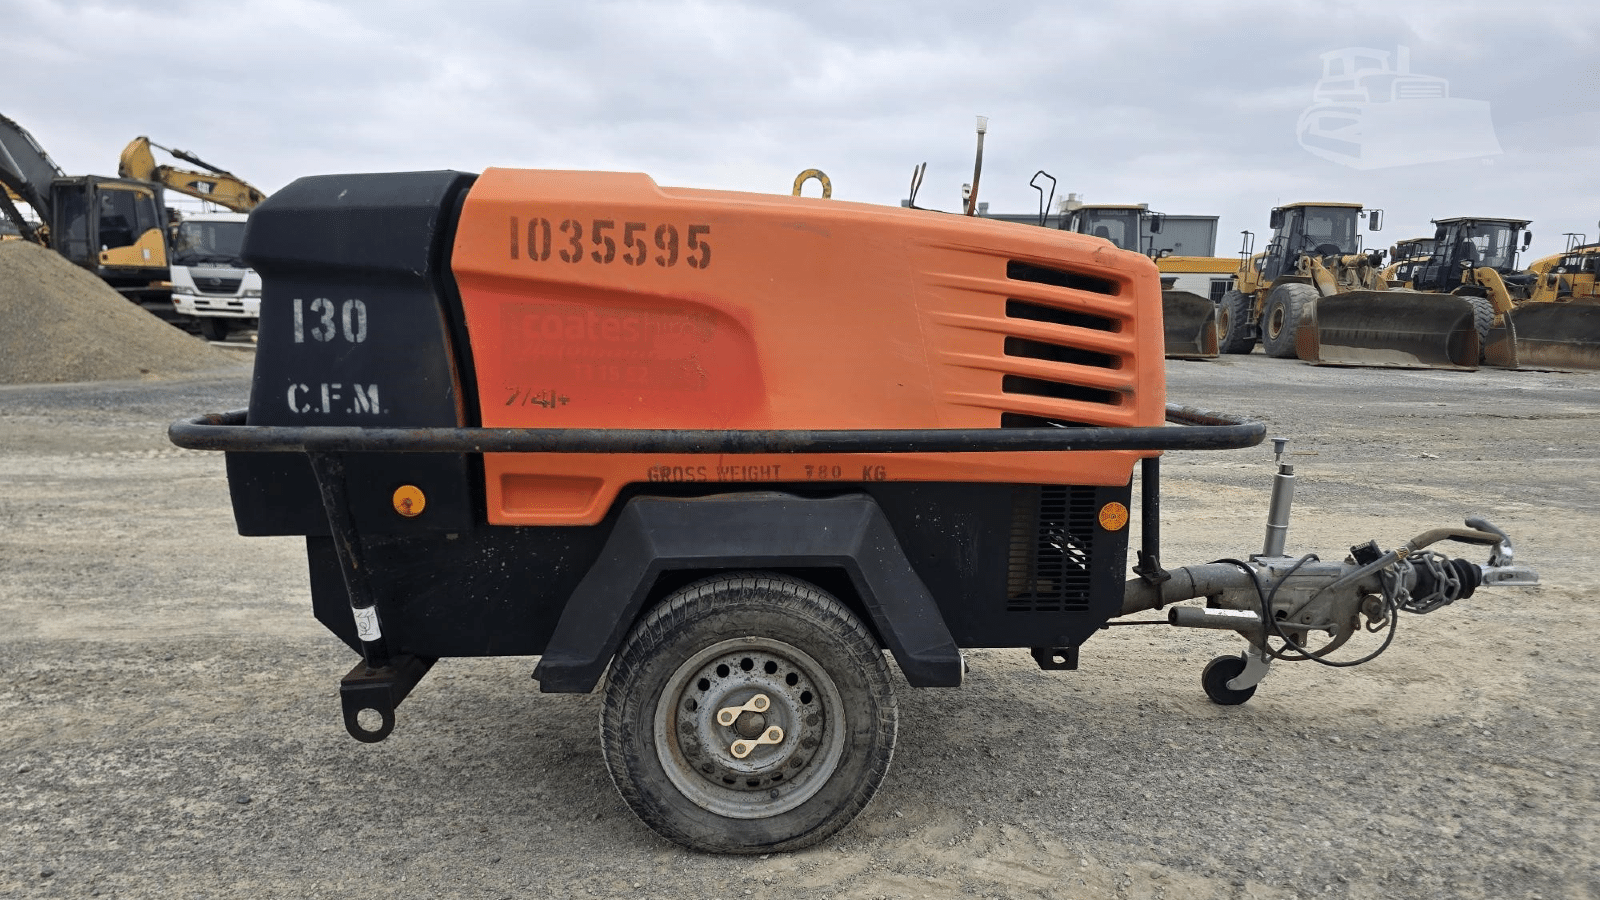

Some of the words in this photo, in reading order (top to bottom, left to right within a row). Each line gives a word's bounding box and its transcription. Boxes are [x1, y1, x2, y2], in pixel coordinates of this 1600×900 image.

[510, 216, 711, 270] 1035595
[293, 298, 367, 343] 130
[647, 466, 707, 481] GROSS
[717, 465, 782, 481] WEIGHT
